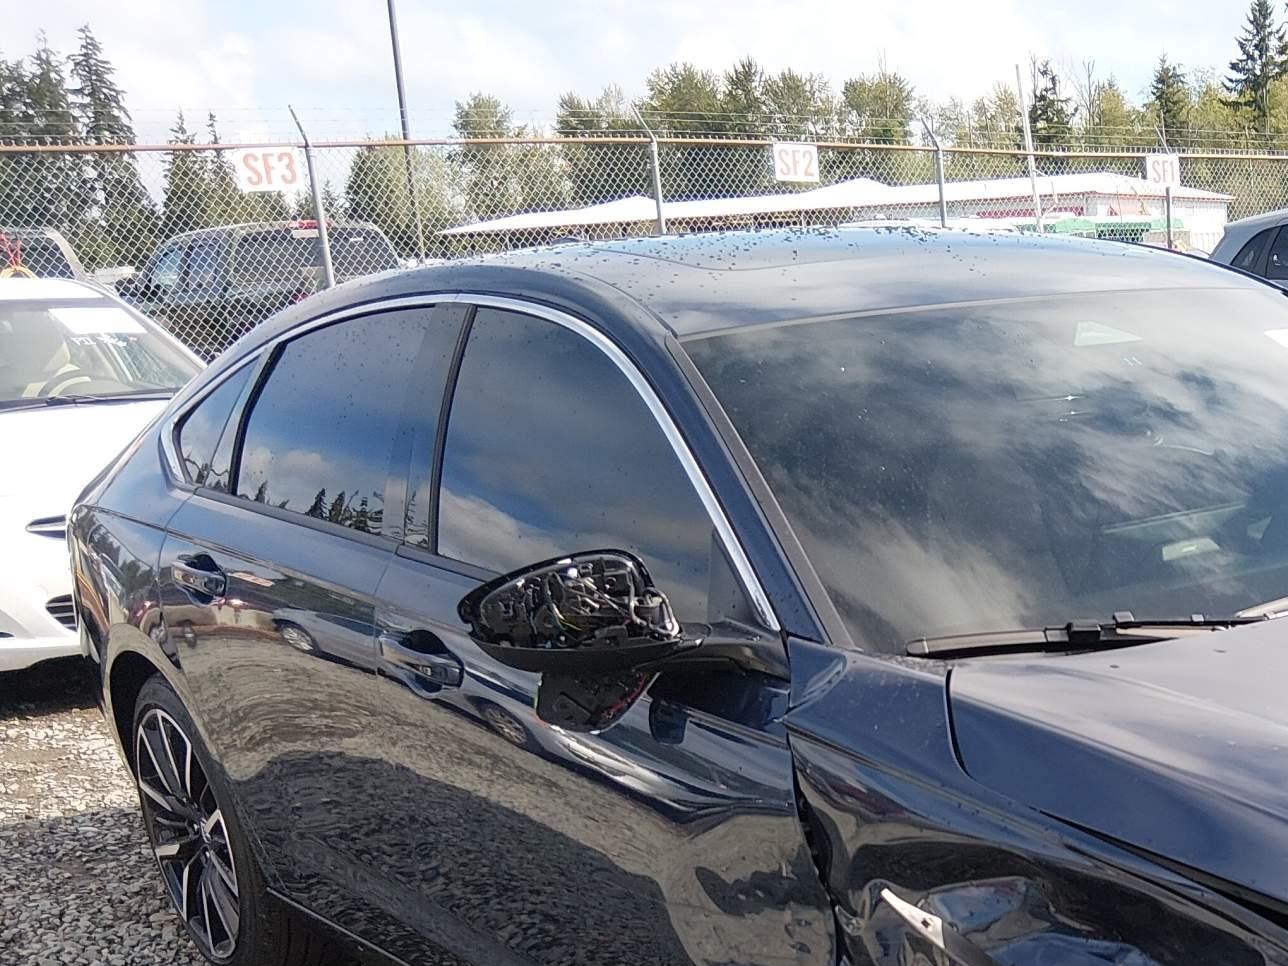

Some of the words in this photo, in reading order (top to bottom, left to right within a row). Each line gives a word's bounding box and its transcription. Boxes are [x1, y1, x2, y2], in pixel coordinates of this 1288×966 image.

[242, 152, 297, 186] SF3
[778, 149, 815, 177] SF2
[1152, 159, 1176, 184] SF1
